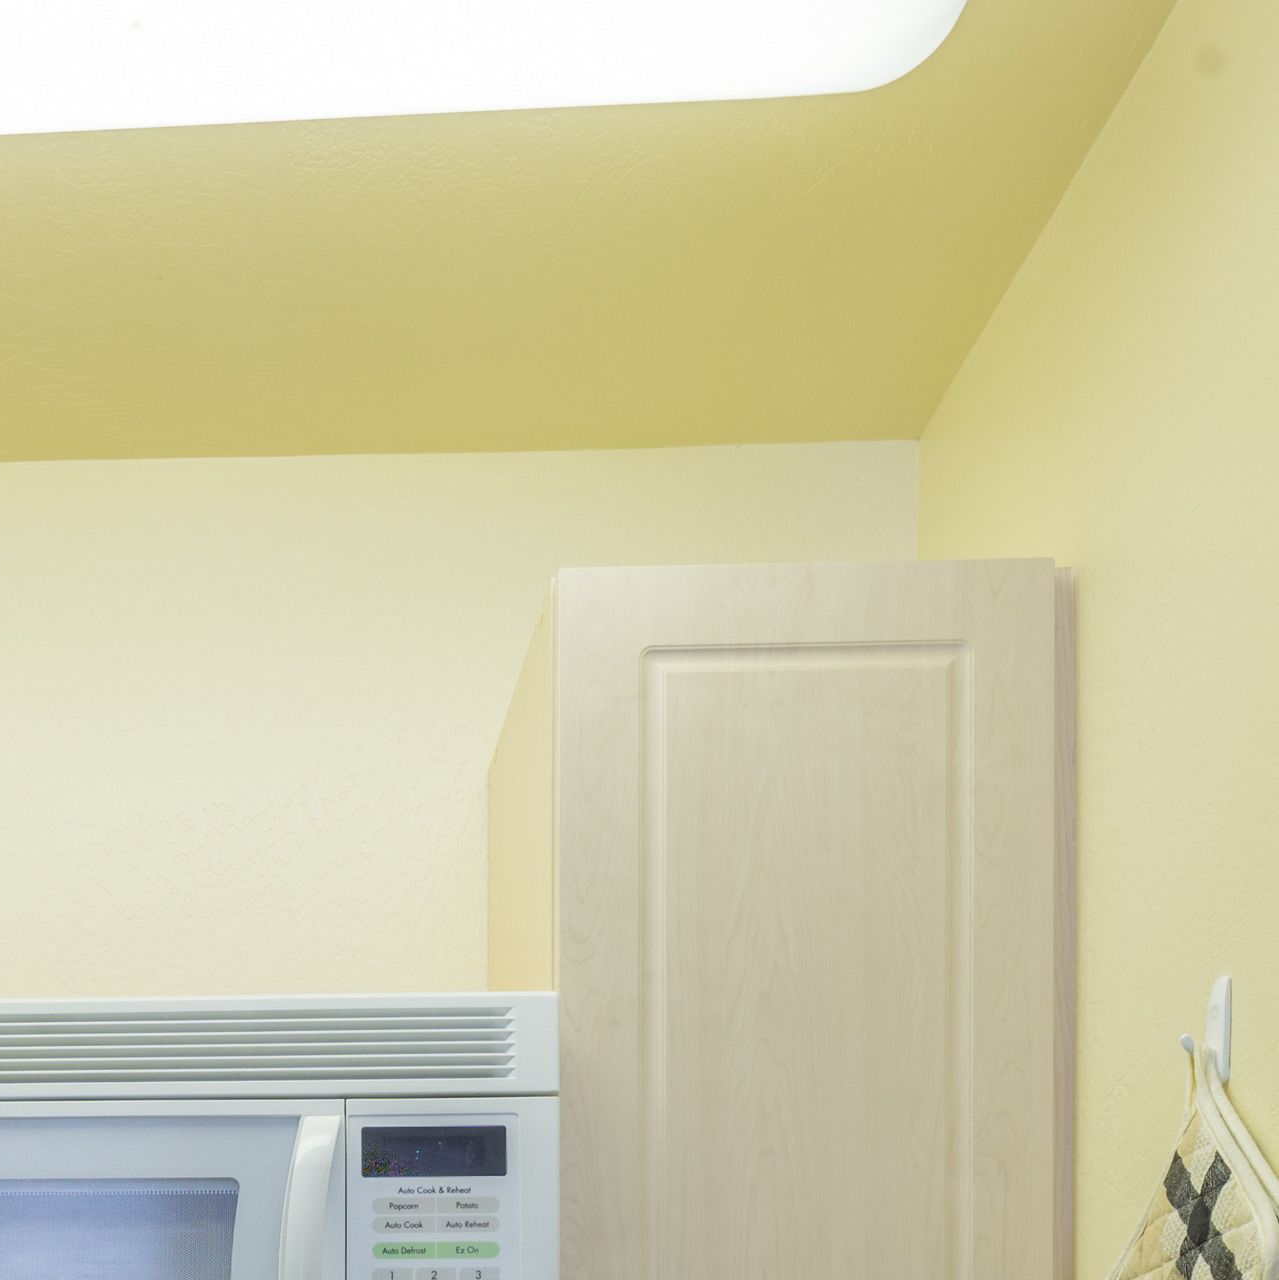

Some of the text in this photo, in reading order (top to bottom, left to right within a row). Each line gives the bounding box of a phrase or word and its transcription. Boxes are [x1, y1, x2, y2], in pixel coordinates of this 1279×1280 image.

[398, 1186, 472, 1194] Auto Cook & Reheat
[389, 1202, 419, 1211] Popcorn
[456, 1201, 479, 1209] Potato
[384, 1220, 423, 1229] Auto Cook
[445, 1220, 490, 1228] Auto Reheat
[382, 1247, 426, 1255] Auto Defrost
[431, 1271, 438, 1280] 2
[475, 1270, 482, 1280] 3
